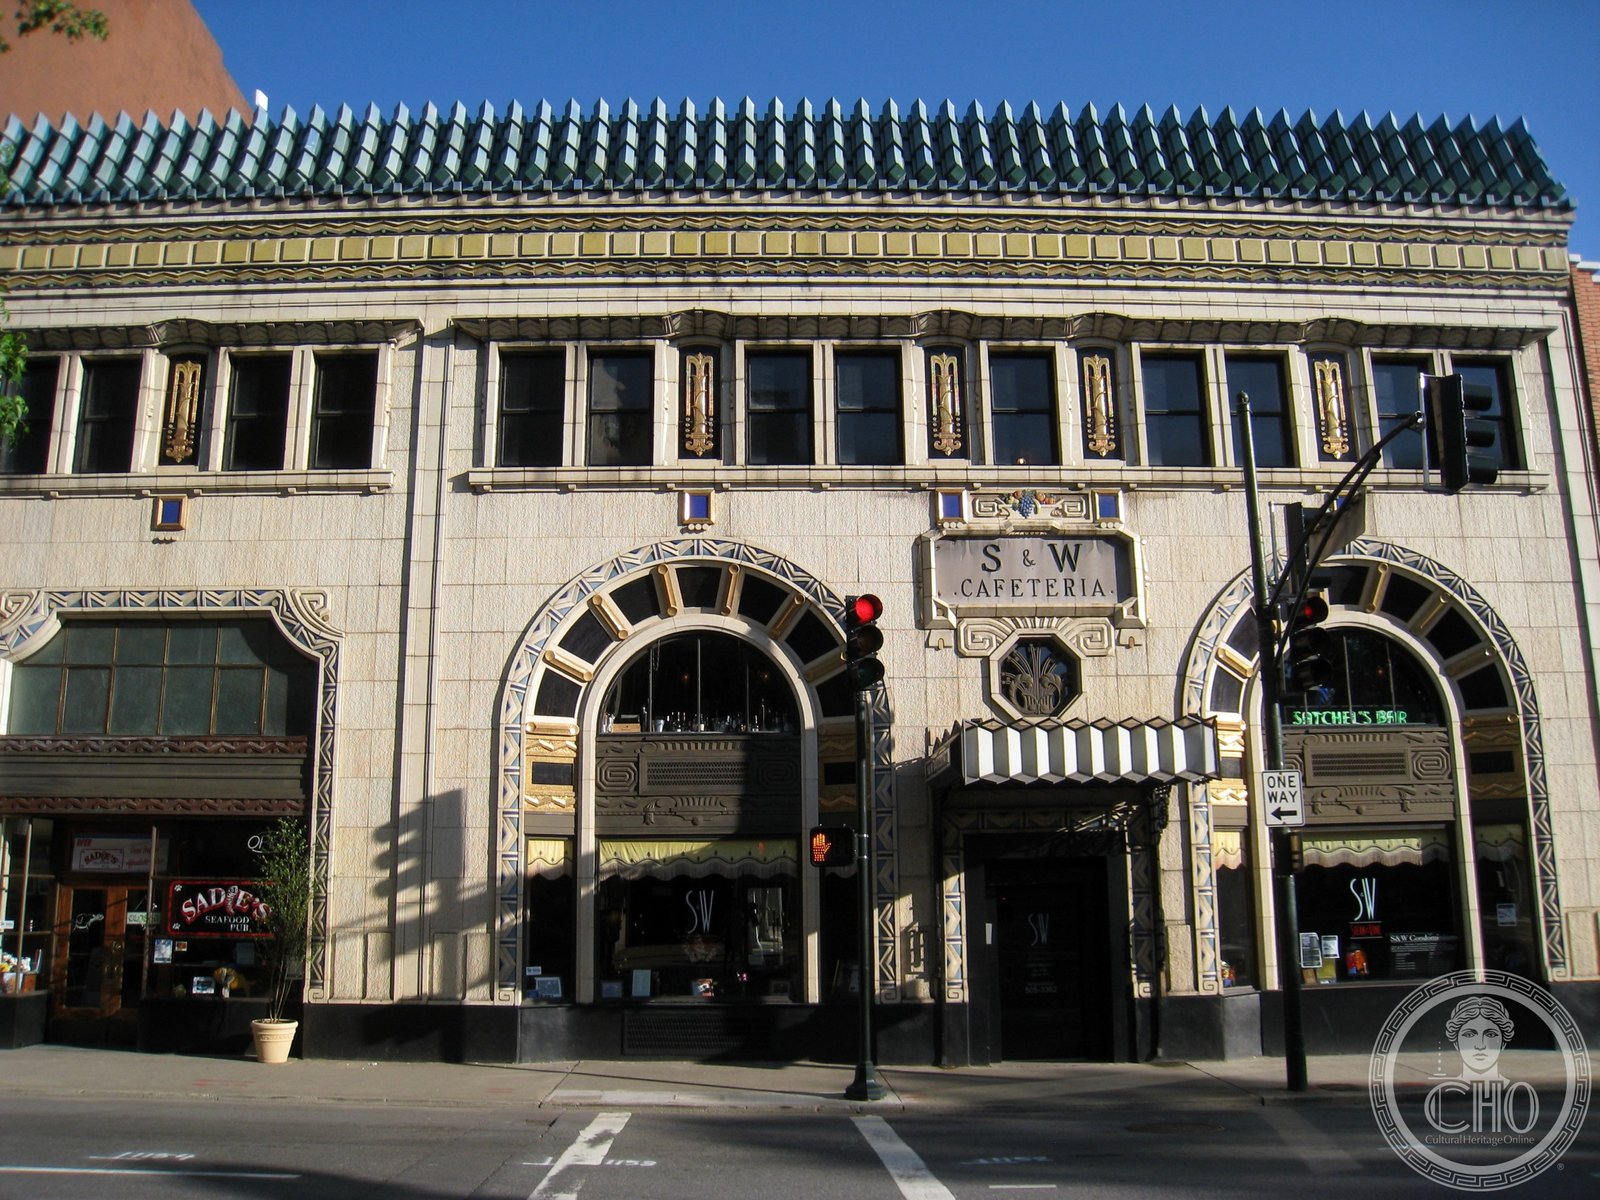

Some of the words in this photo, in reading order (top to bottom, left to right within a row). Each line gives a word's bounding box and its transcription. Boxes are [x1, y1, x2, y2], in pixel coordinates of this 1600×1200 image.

[981, 543, 1002, 573] S
[1022, 548, 1036, 567] &
[1047, 543, 1083, 573] W
[960, 578, 1106, 598] CAFETERIA
[1292, 710, 1372, 725] SATCHEL'S
[1375, 709, 1408, 725] BAR
[1266, 775, 1296, 788] ONE
[1267, 790, 1298, 804] WAY
[181, 885, 272, 927] SADIE'S
[205, 915, 250, 924] SEAFOOD
[230, 924, 250, 932] PUB
